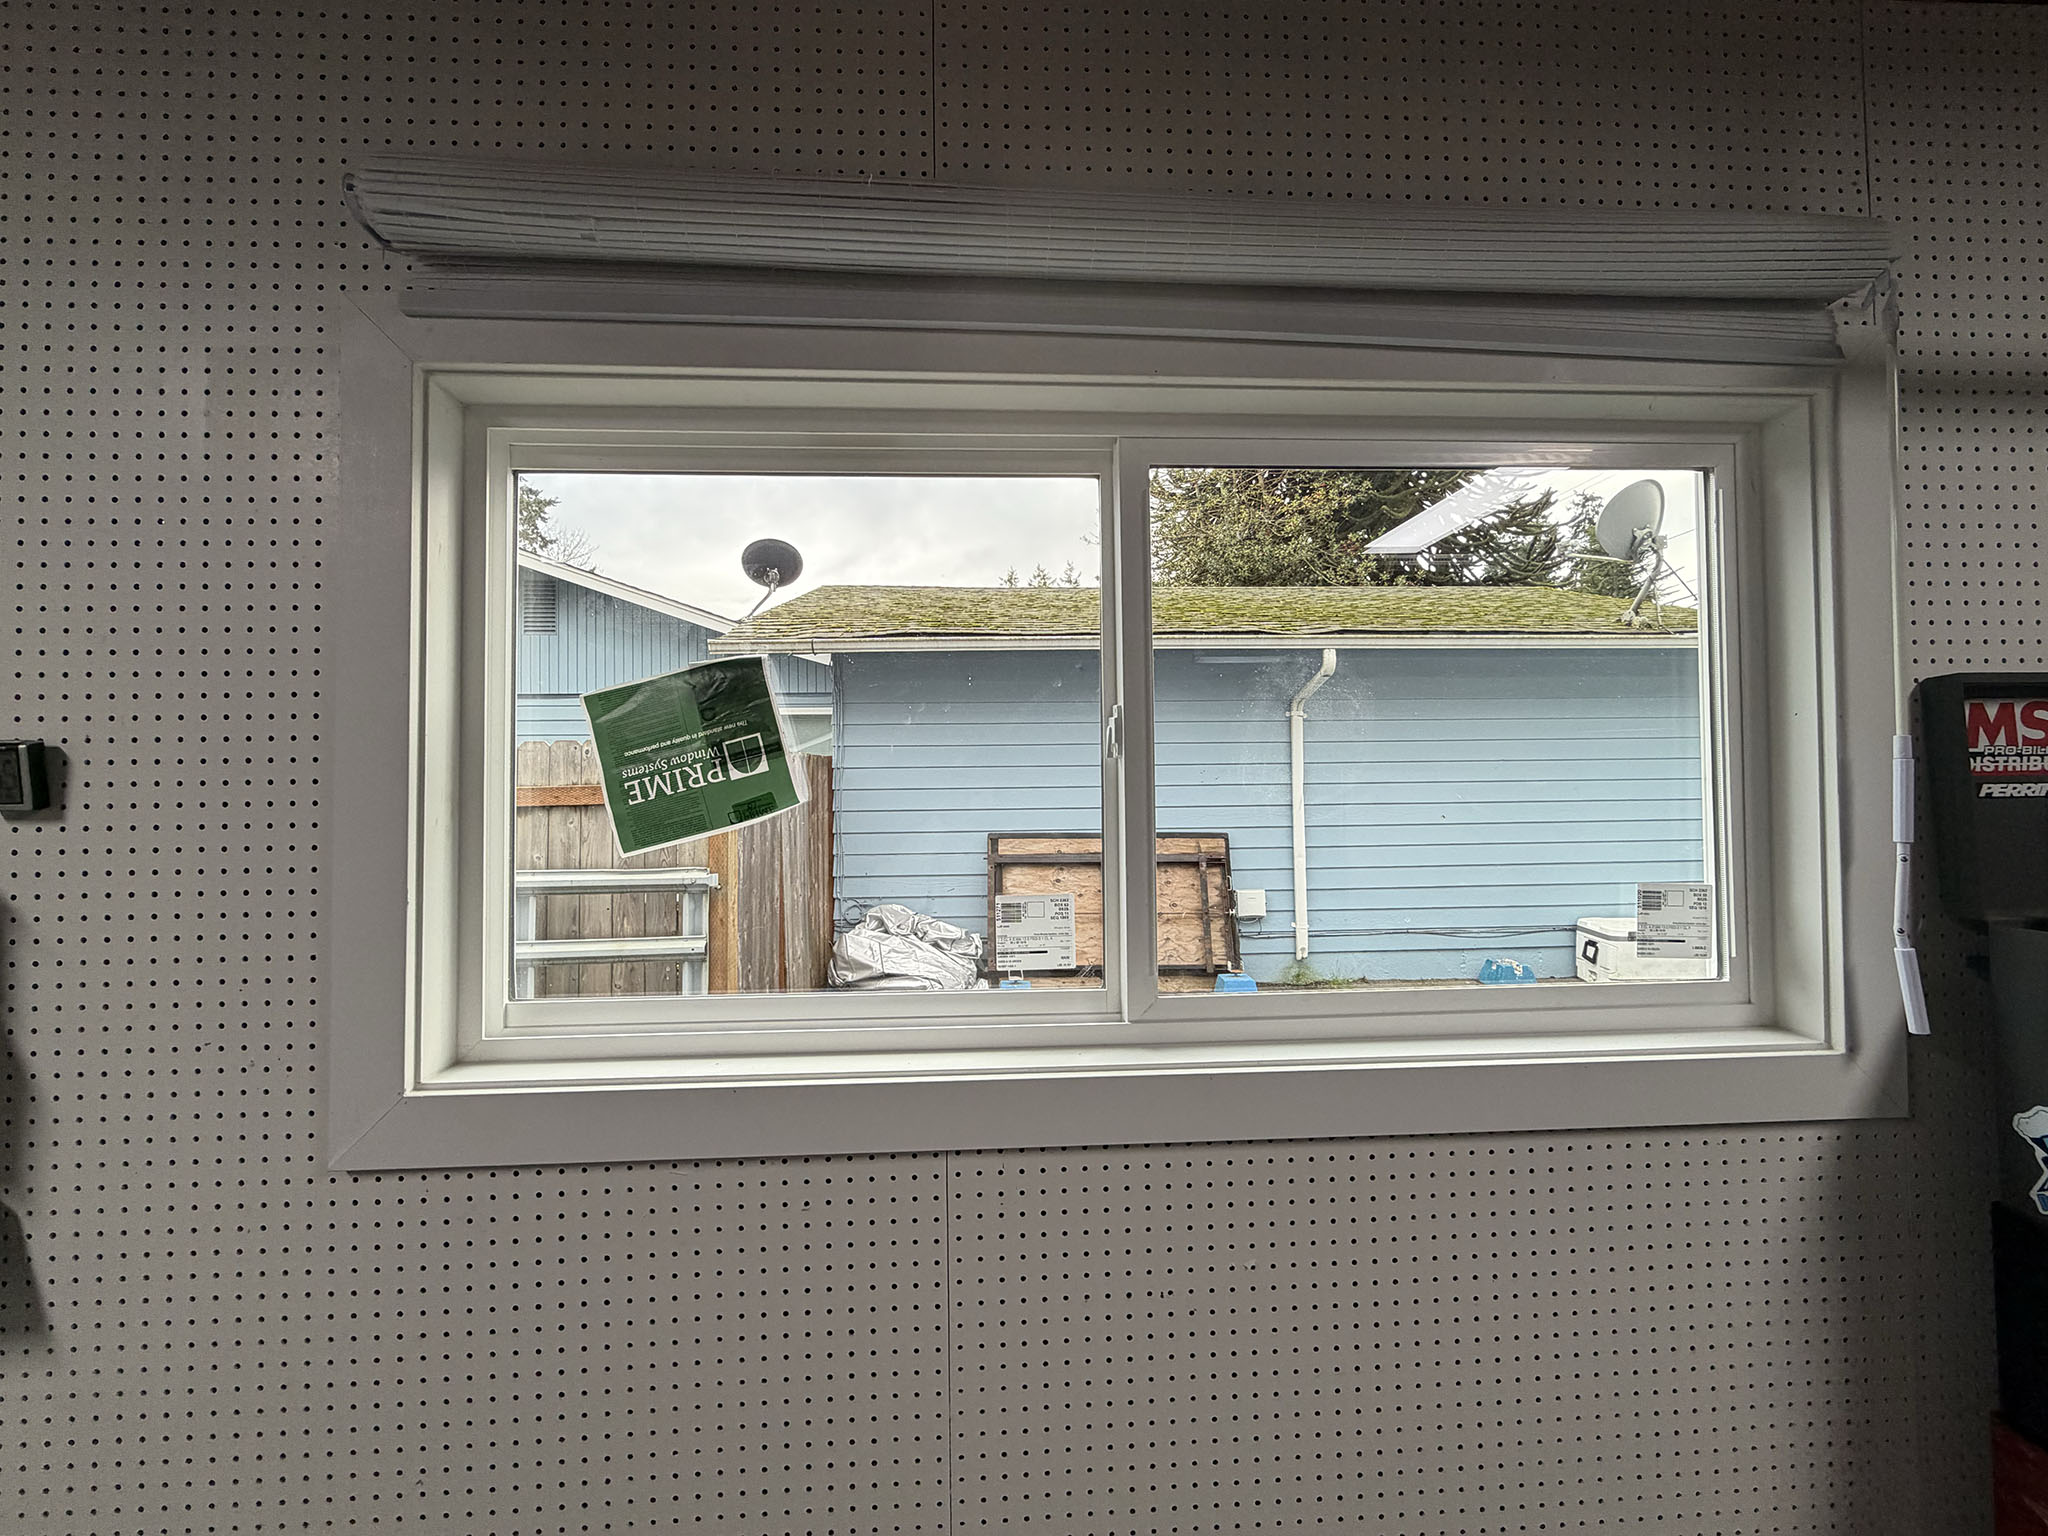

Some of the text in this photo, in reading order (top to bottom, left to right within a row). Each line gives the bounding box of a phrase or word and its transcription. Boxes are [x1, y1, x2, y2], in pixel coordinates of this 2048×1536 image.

[723, 722, 736, 730] new
[737, 719, 748, 727] The
[698, 725, 723, 737] standard
[660, 739, 671, 747] and
[672, 733, 691, 744] quality
[624, 741, 659, 757] performance
[622, 746, 721, 780] Window Systems
[624, 758, 726, 805] PRIME
